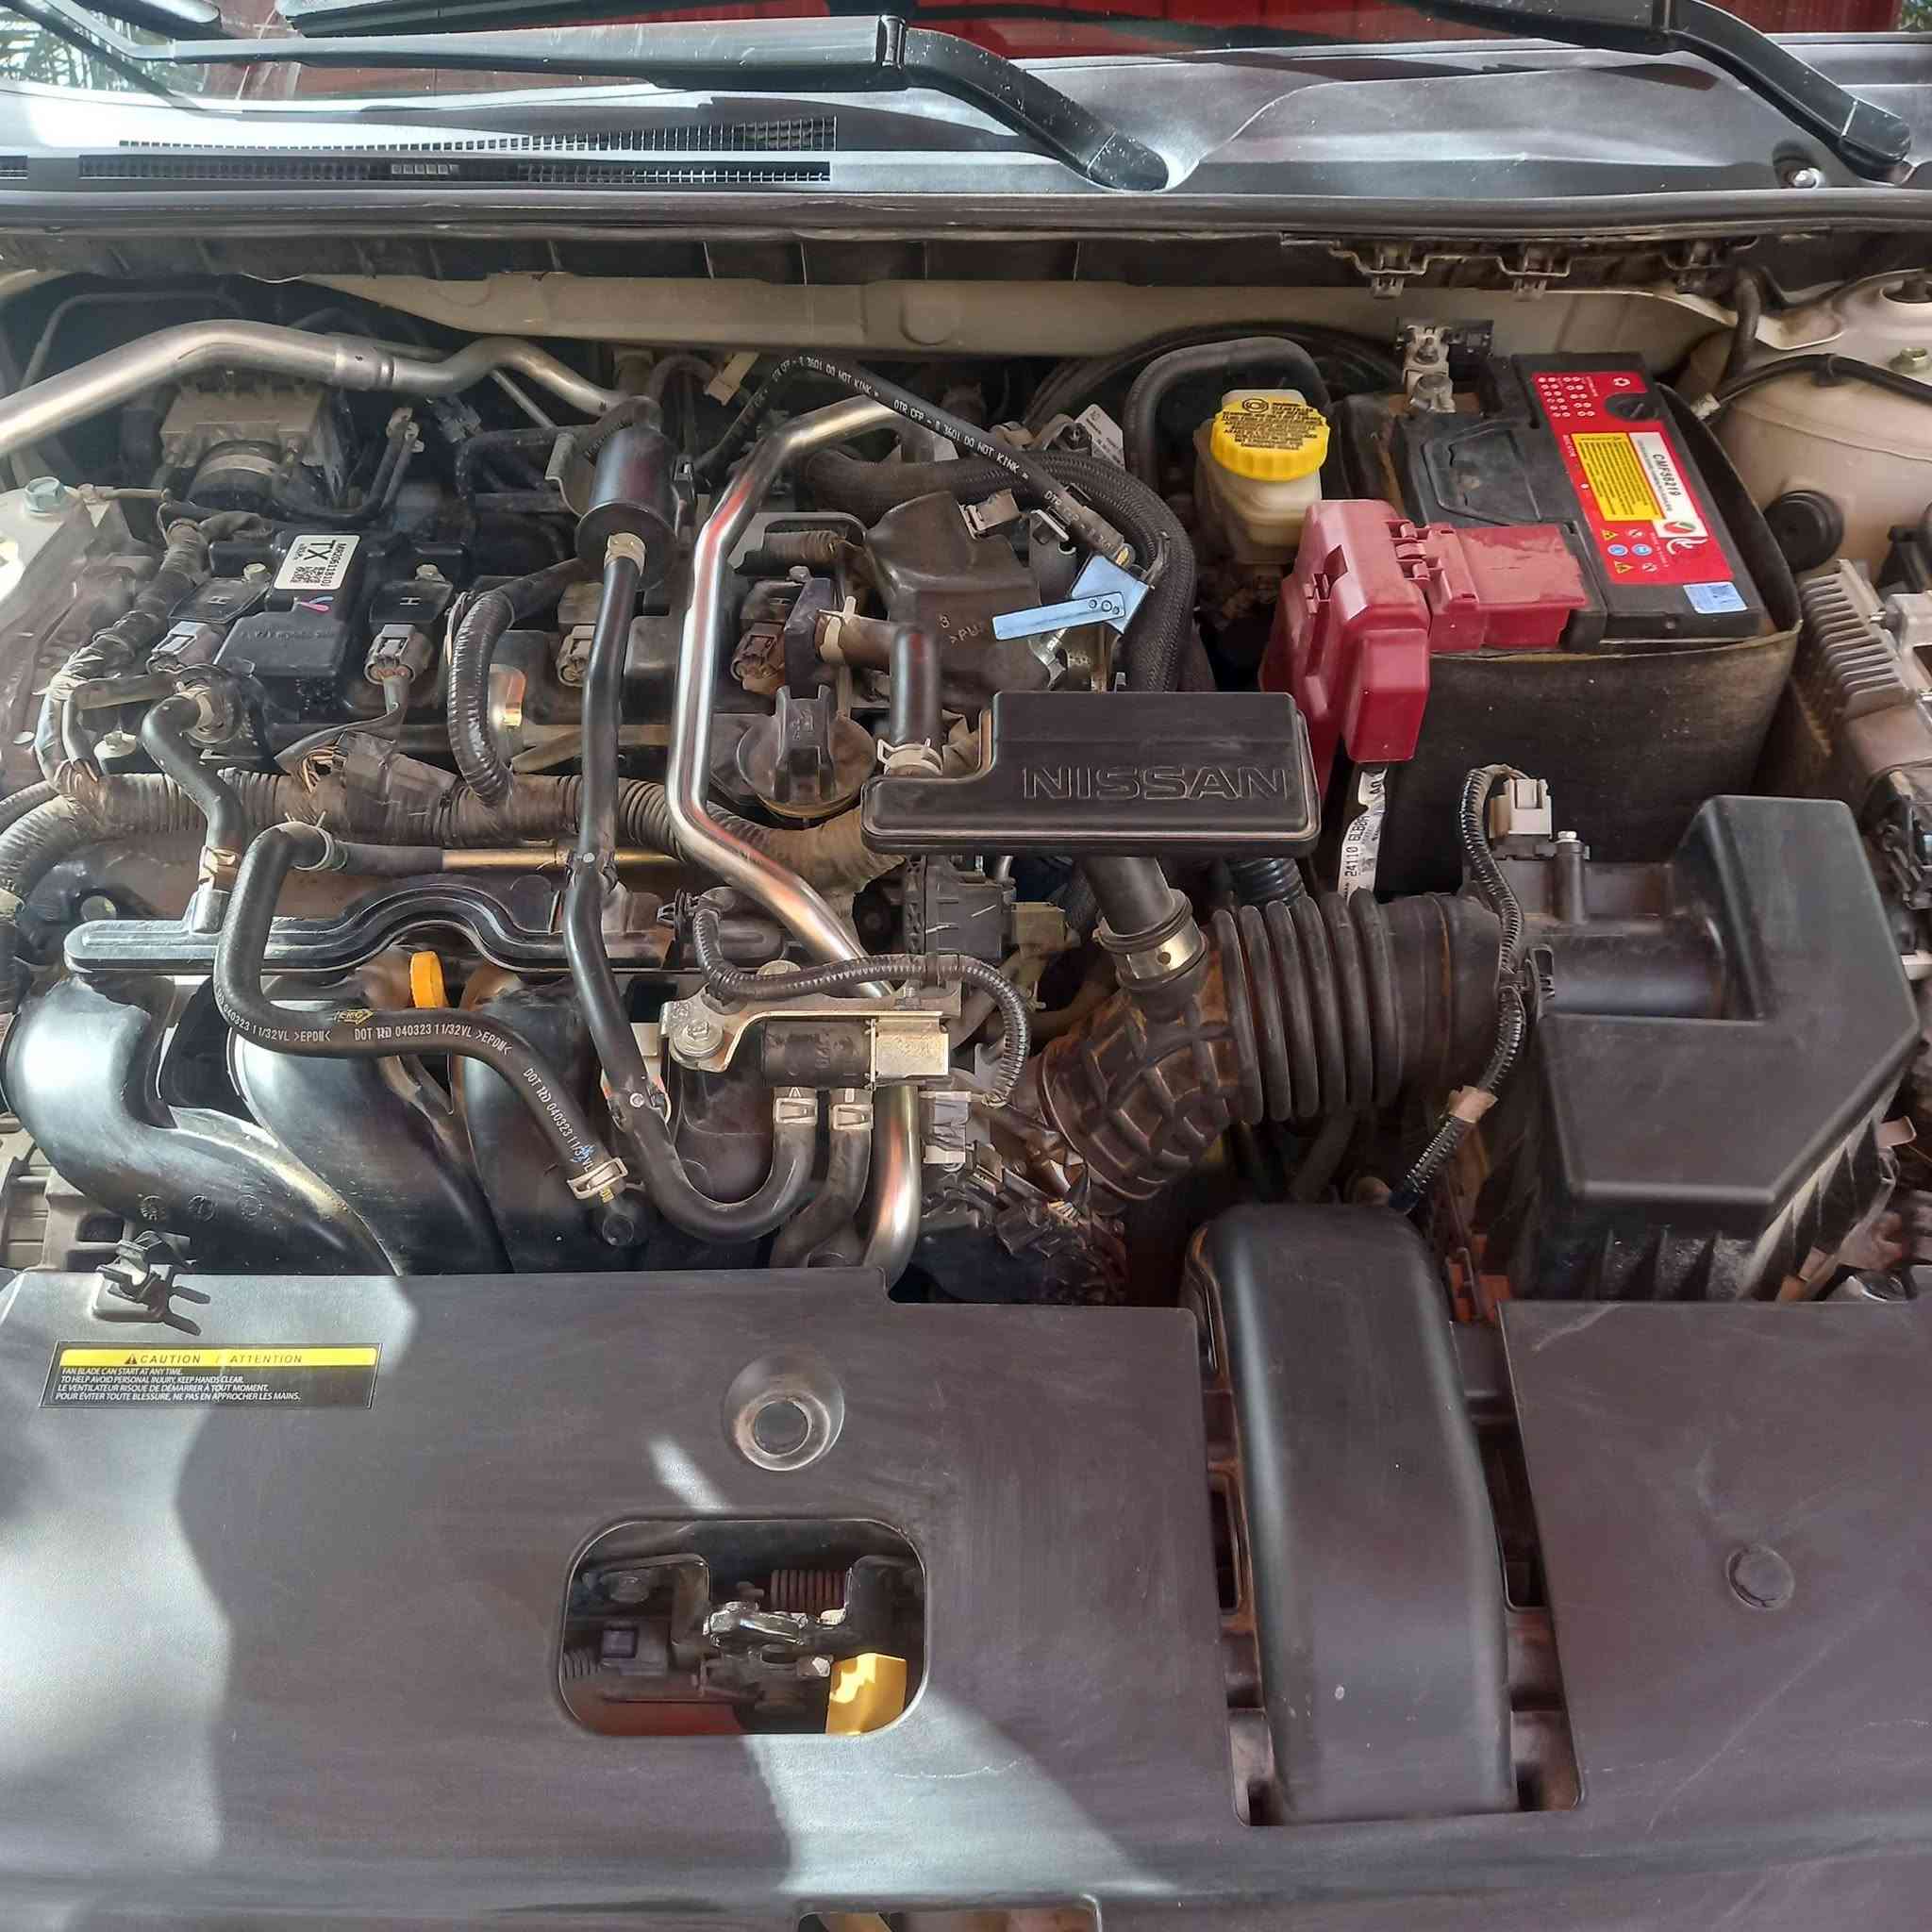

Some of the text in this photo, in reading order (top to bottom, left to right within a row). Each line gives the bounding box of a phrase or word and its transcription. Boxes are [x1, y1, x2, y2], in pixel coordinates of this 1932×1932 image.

[977, 441, 995, 458] NOT
[996, 452, 1021, 474] KINK
[303, 540, 336, 560] TX
[1023, 766, 1289, 800] NISSAN
[1344, 846, 1359, 877] 24110
[224, 1004, 250, 1031] 040323
[395, 1024, 432, 1038] 040323
[546, 1102, 574, 1138] 040323
[140, 1355, 201, 1364] CAUTION
[229, 1355, 303, 1364] ATTENTION
[79, 1391, 105, 1400] ÉVITER
[161, 1383, 203, 1391] DÉMARRER
[204, 1383, 209, 1391] À
